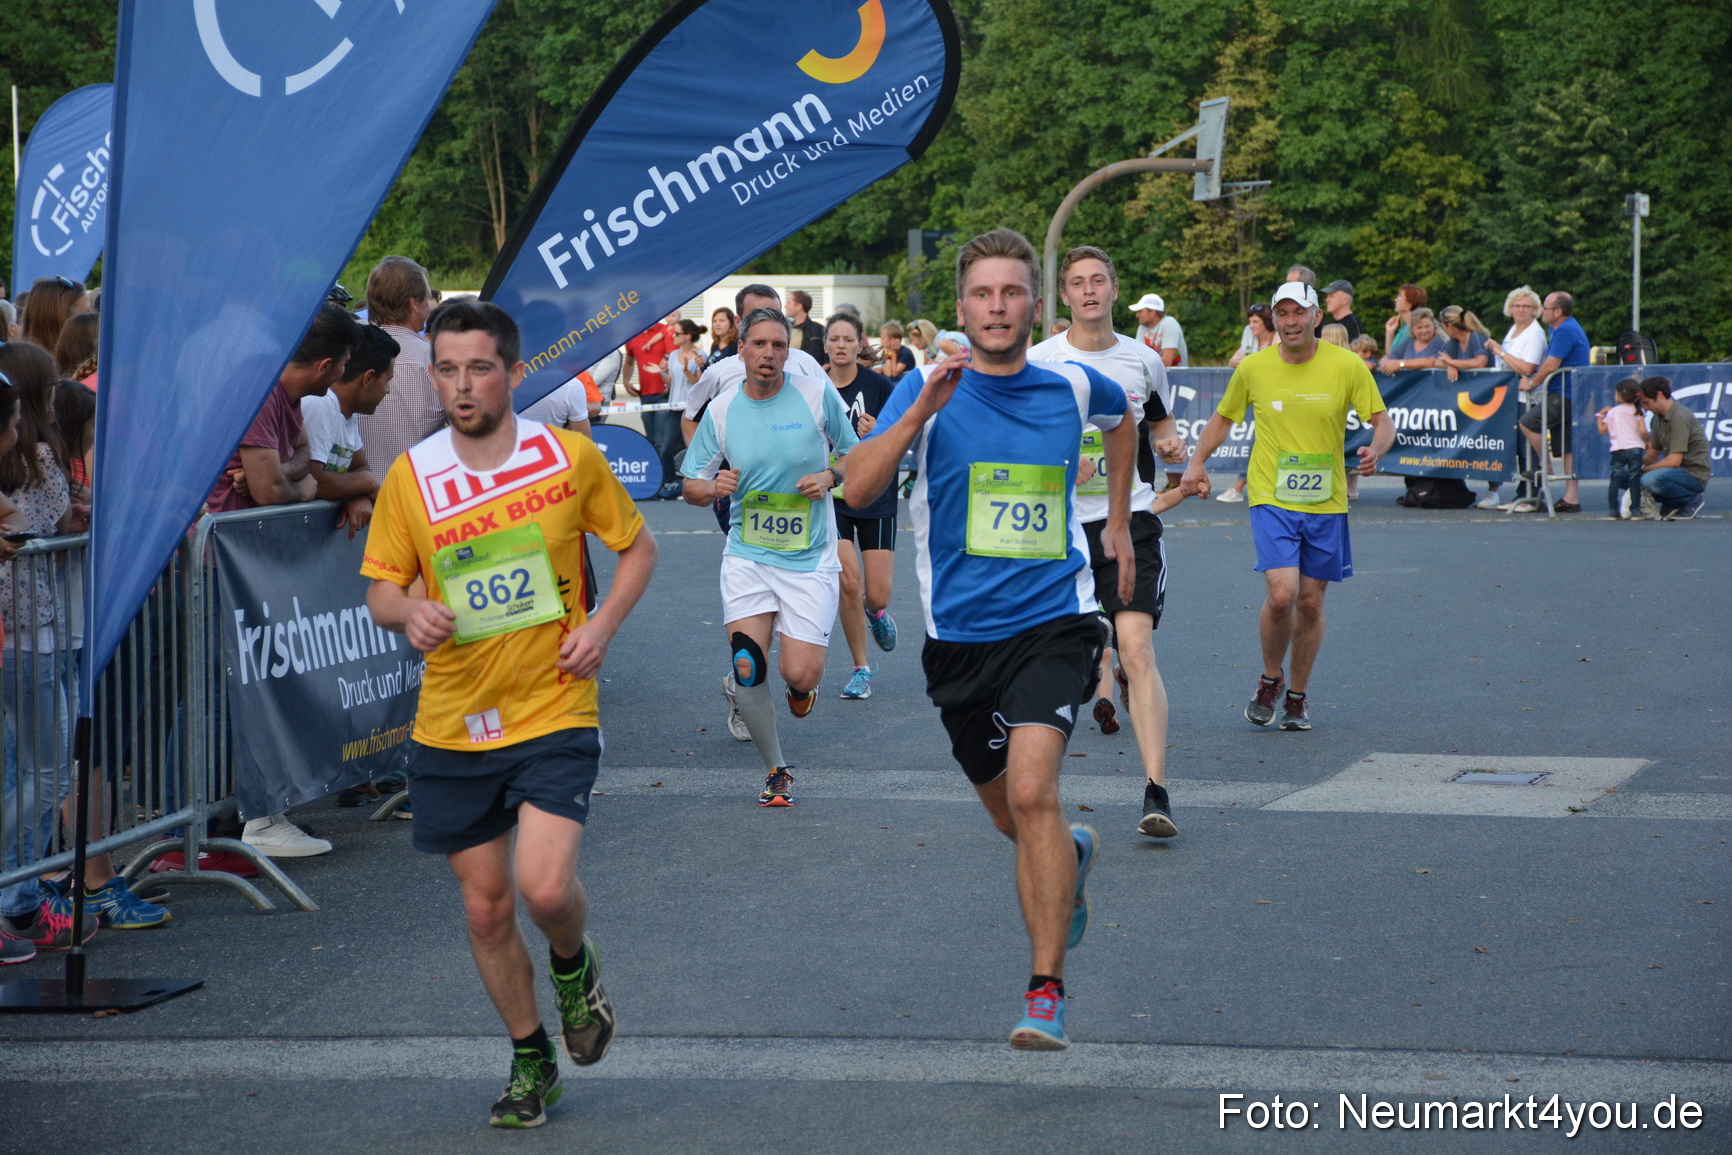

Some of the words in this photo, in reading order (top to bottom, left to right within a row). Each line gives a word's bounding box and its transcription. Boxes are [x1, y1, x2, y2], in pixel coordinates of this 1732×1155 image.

[731, 150, 801, 206] Druck
[803, 126, 849, 162] und
[848, 73, 930, 140] Medien
[537, 93, 832, 290] Frischmann
[1396, 432, 1433, 448] Druck
[1433, 434, 1458, 449] und
[1457, 434, 1505, 451] Medien
[1286, 473, 1323, 491] 622
[1399, 455, 1504, 472] www.frischmann-net.de
[433, 511, 500, 551] MAX
[505, 480, 577, 522] BÖGL
[750, 512, 803, 536] 1496
[990, 501, 1049, 533] 793
[465, 567, 536, 611] 862
[337, 669, 376, 710] Druck
[376, 661, 402, 700] und
